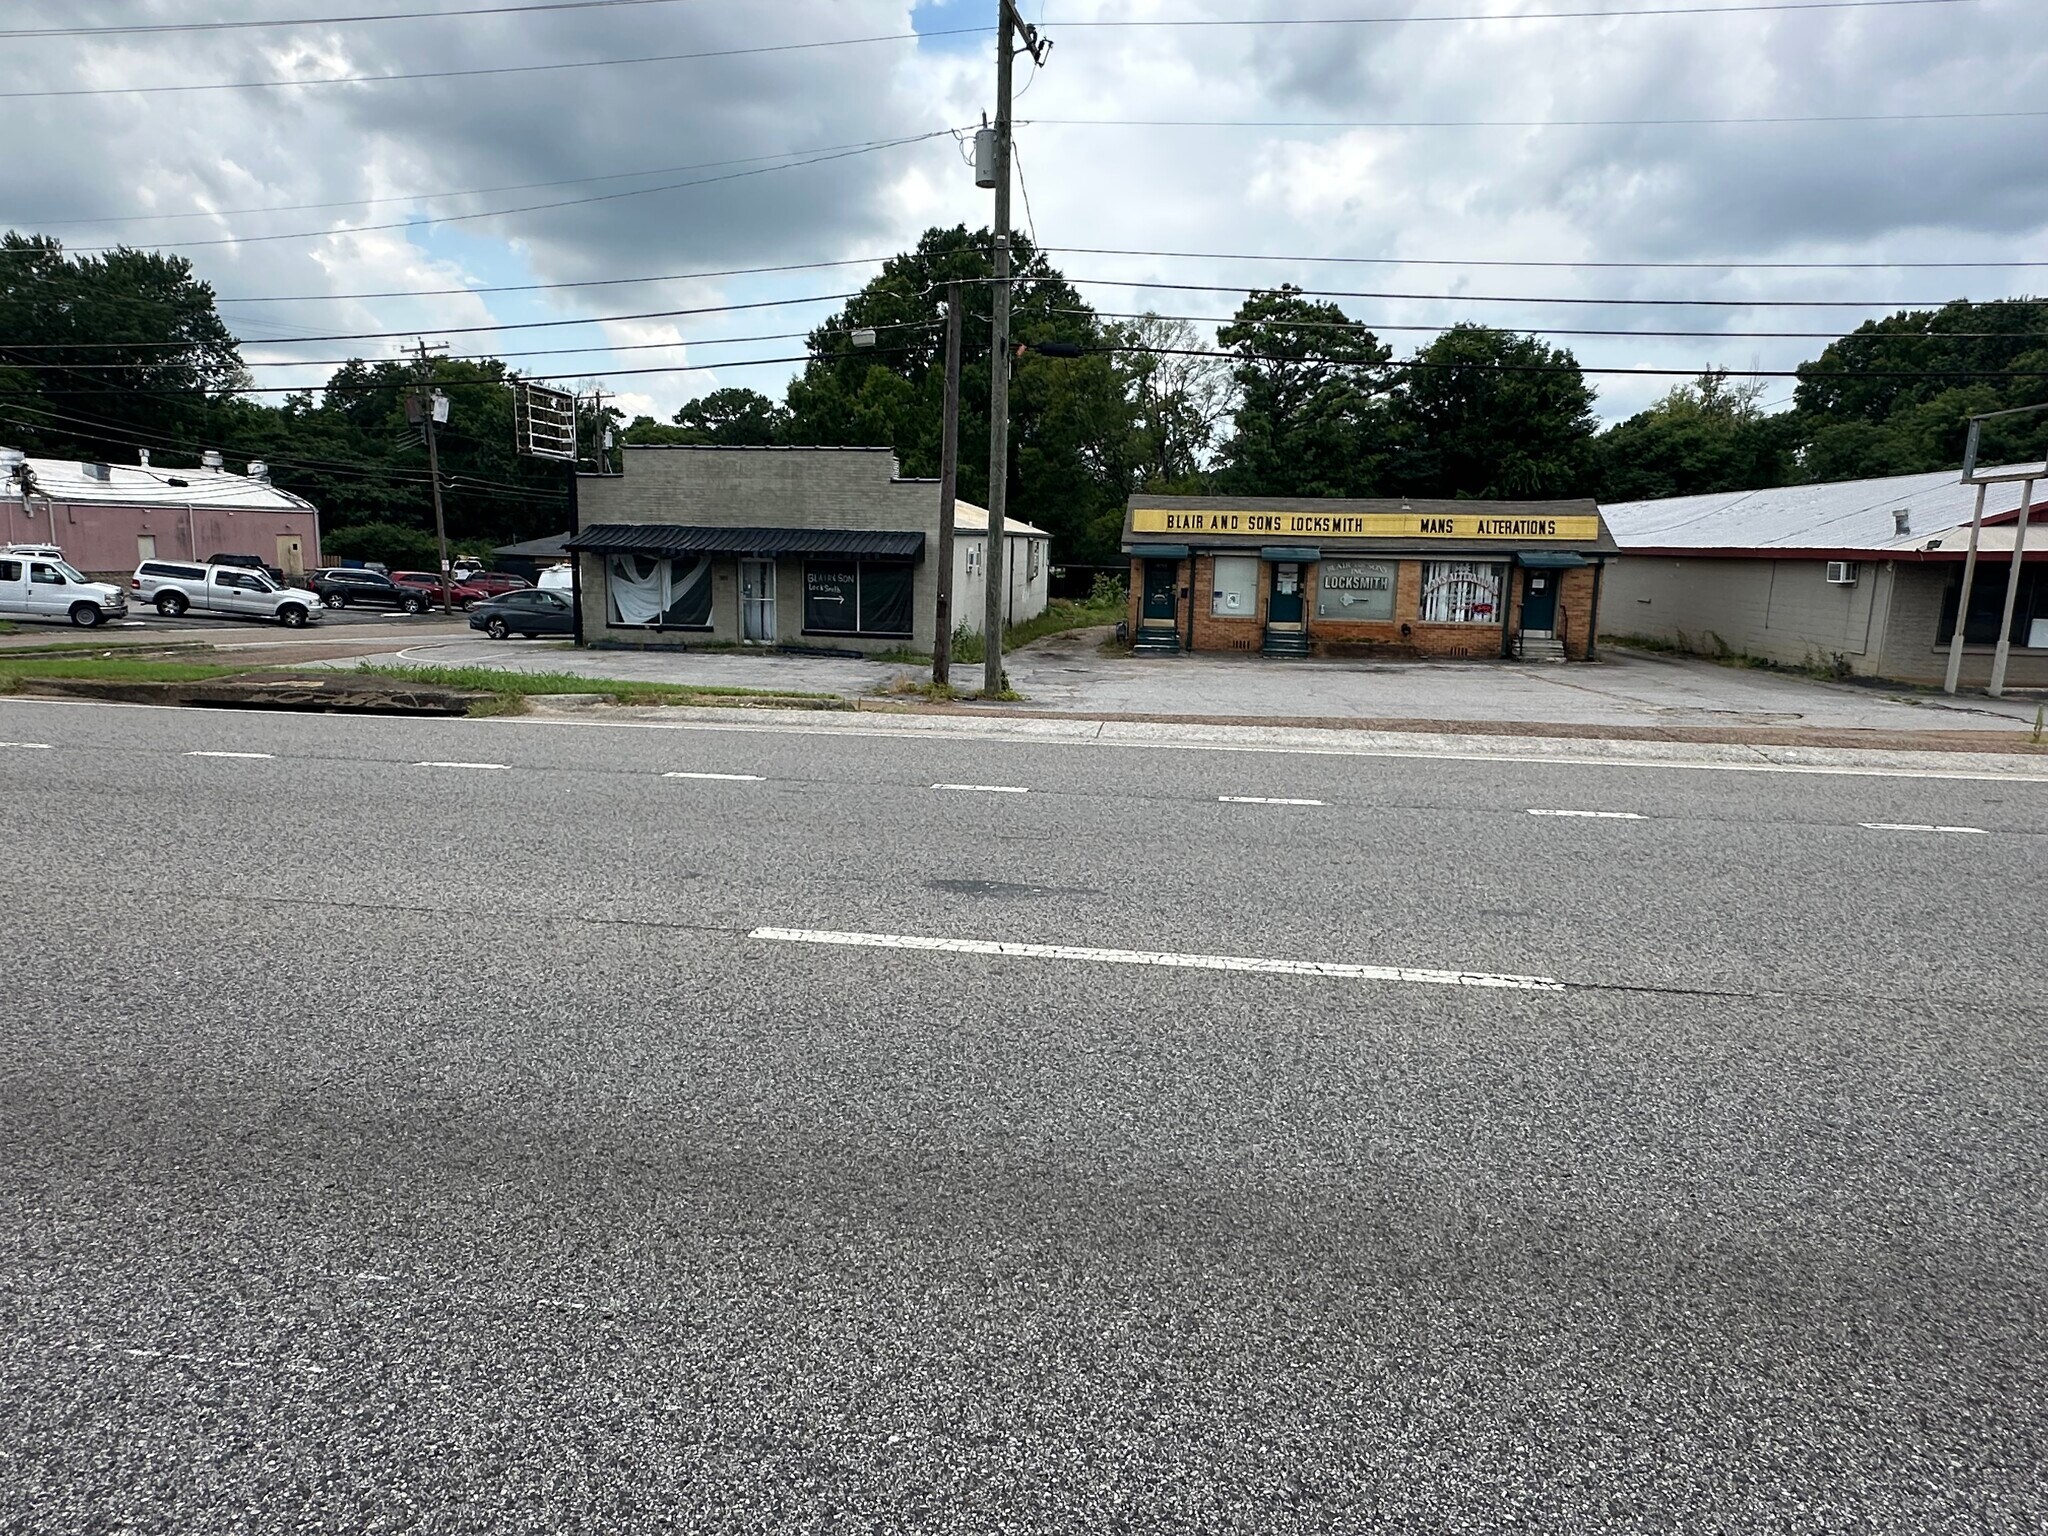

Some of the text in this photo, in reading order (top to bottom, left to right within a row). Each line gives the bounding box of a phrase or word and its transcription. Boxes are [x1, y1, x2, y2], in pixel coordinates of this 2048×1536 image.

[1167, 514, 1363, 532] BLAIR AND SONS LOCKSMITH
[1420, 519, 1556, 535] MANS ALTERATIONS
[1324, 575, 1389, 590] LOCKSMITH
